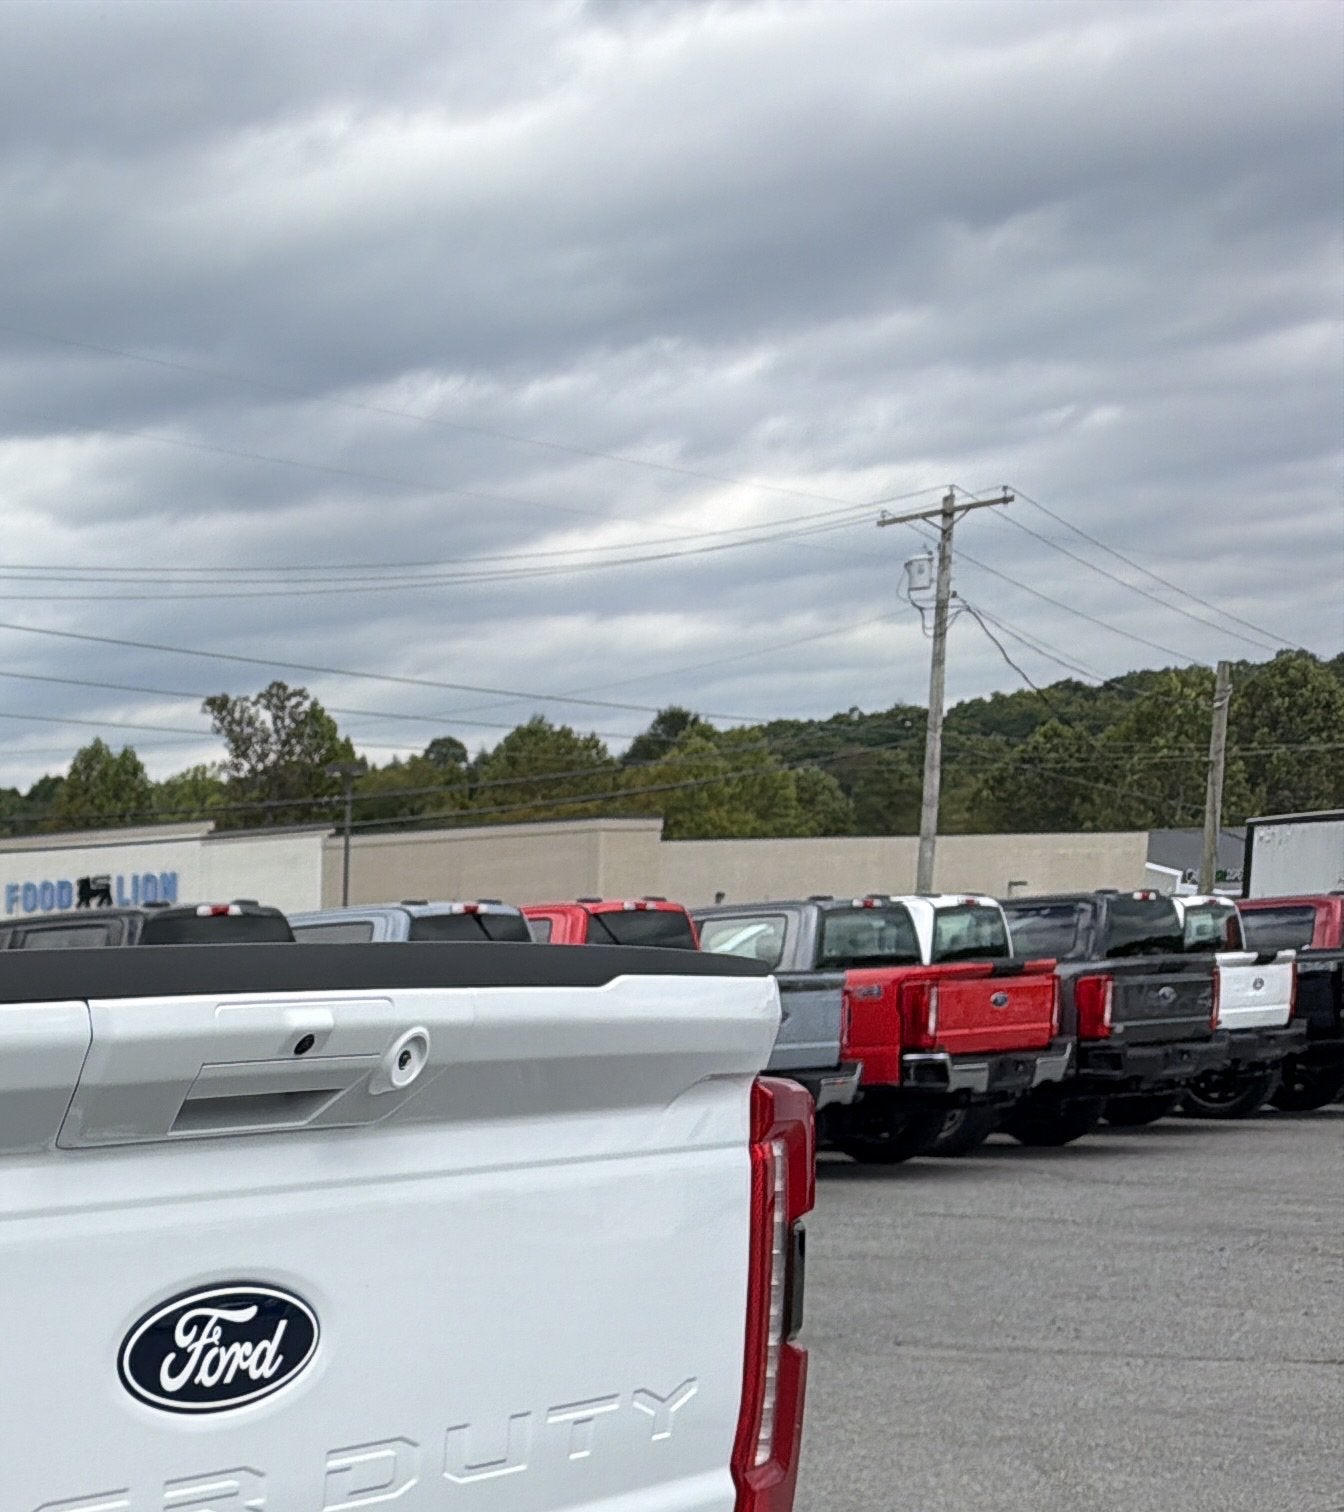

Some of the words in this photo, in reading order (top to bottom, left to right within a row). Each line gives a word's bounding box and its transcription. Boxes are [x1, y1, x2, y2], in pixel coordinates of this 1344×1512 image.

[5, 880, 73, 914] FOOD
[116, 871, 178, 907] LION
[160, 1305, 288, 1392] Ford
